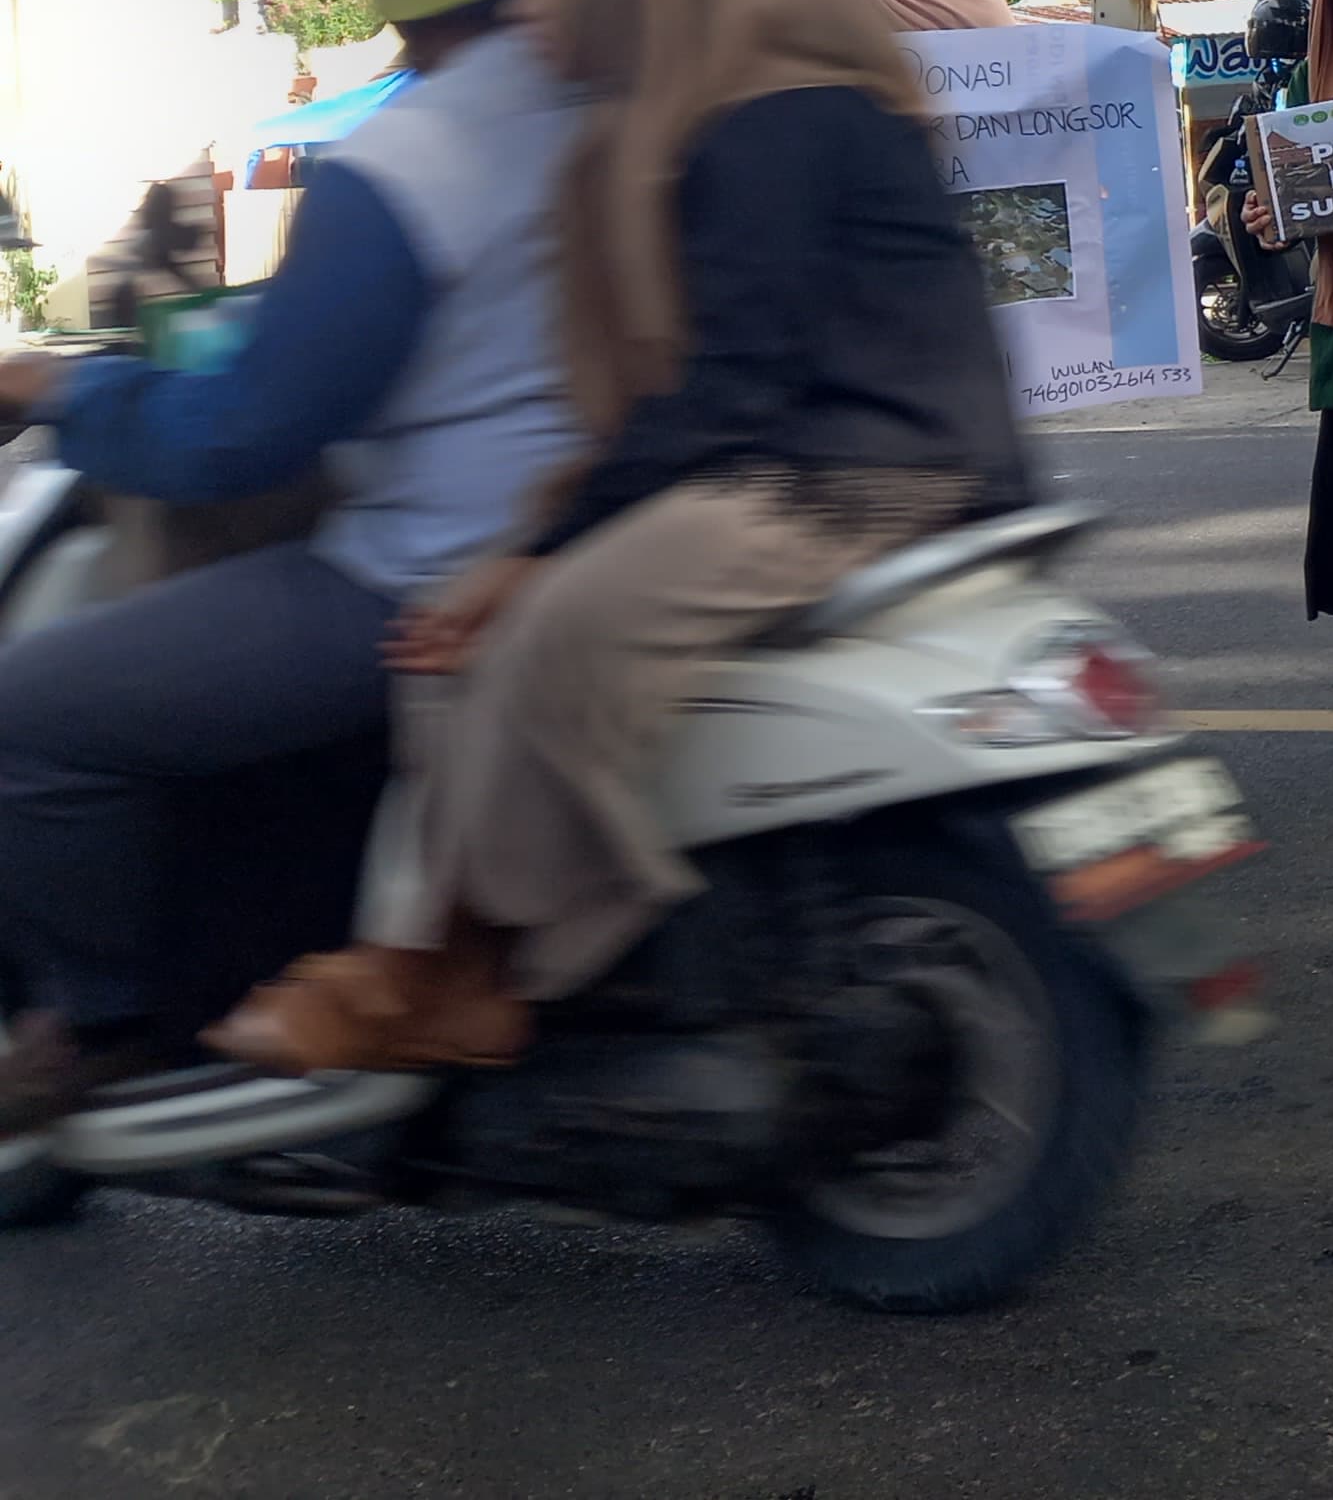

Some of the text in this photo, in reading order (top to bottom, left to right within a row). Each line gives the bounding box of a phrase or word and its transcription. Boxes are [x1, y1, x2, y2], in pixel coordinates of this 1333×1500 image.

[955, 115, 1010, 141] DAN
[1018, 102, 1142, 136] LONGSOR
[1051, 359, 1115, 381] WULAN
[1162, 367, 1192, 382] 533
